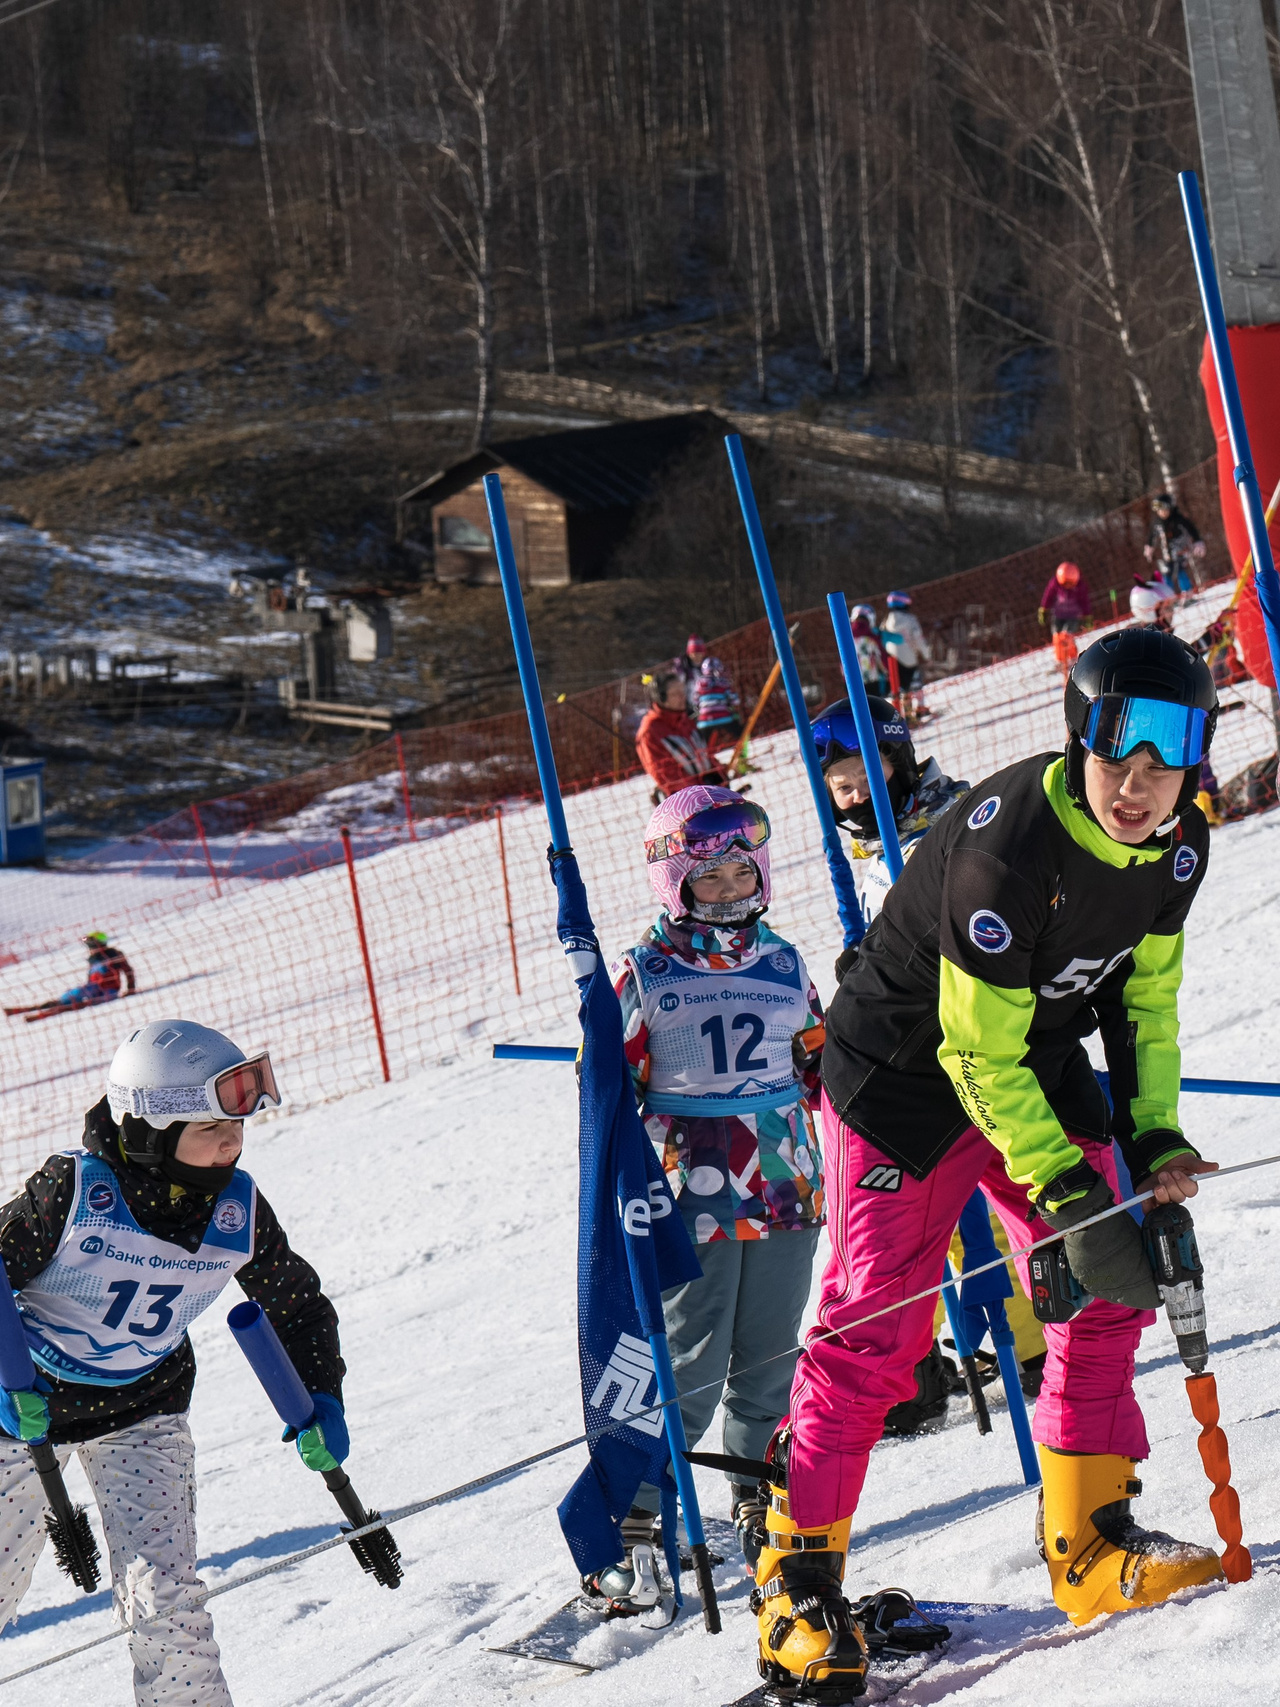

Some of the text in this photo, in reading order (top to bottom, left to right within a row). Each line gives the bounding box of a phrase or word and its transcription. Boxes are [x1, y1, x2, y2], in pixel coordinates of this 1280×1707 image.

[683, 989, 795, 1005] Банк Финсервис
[700, 1012, 769, 1075] 12
[104, 1244, 231, 1274] Банк Финсервис
[101, 1279, 185, 1338] 13
